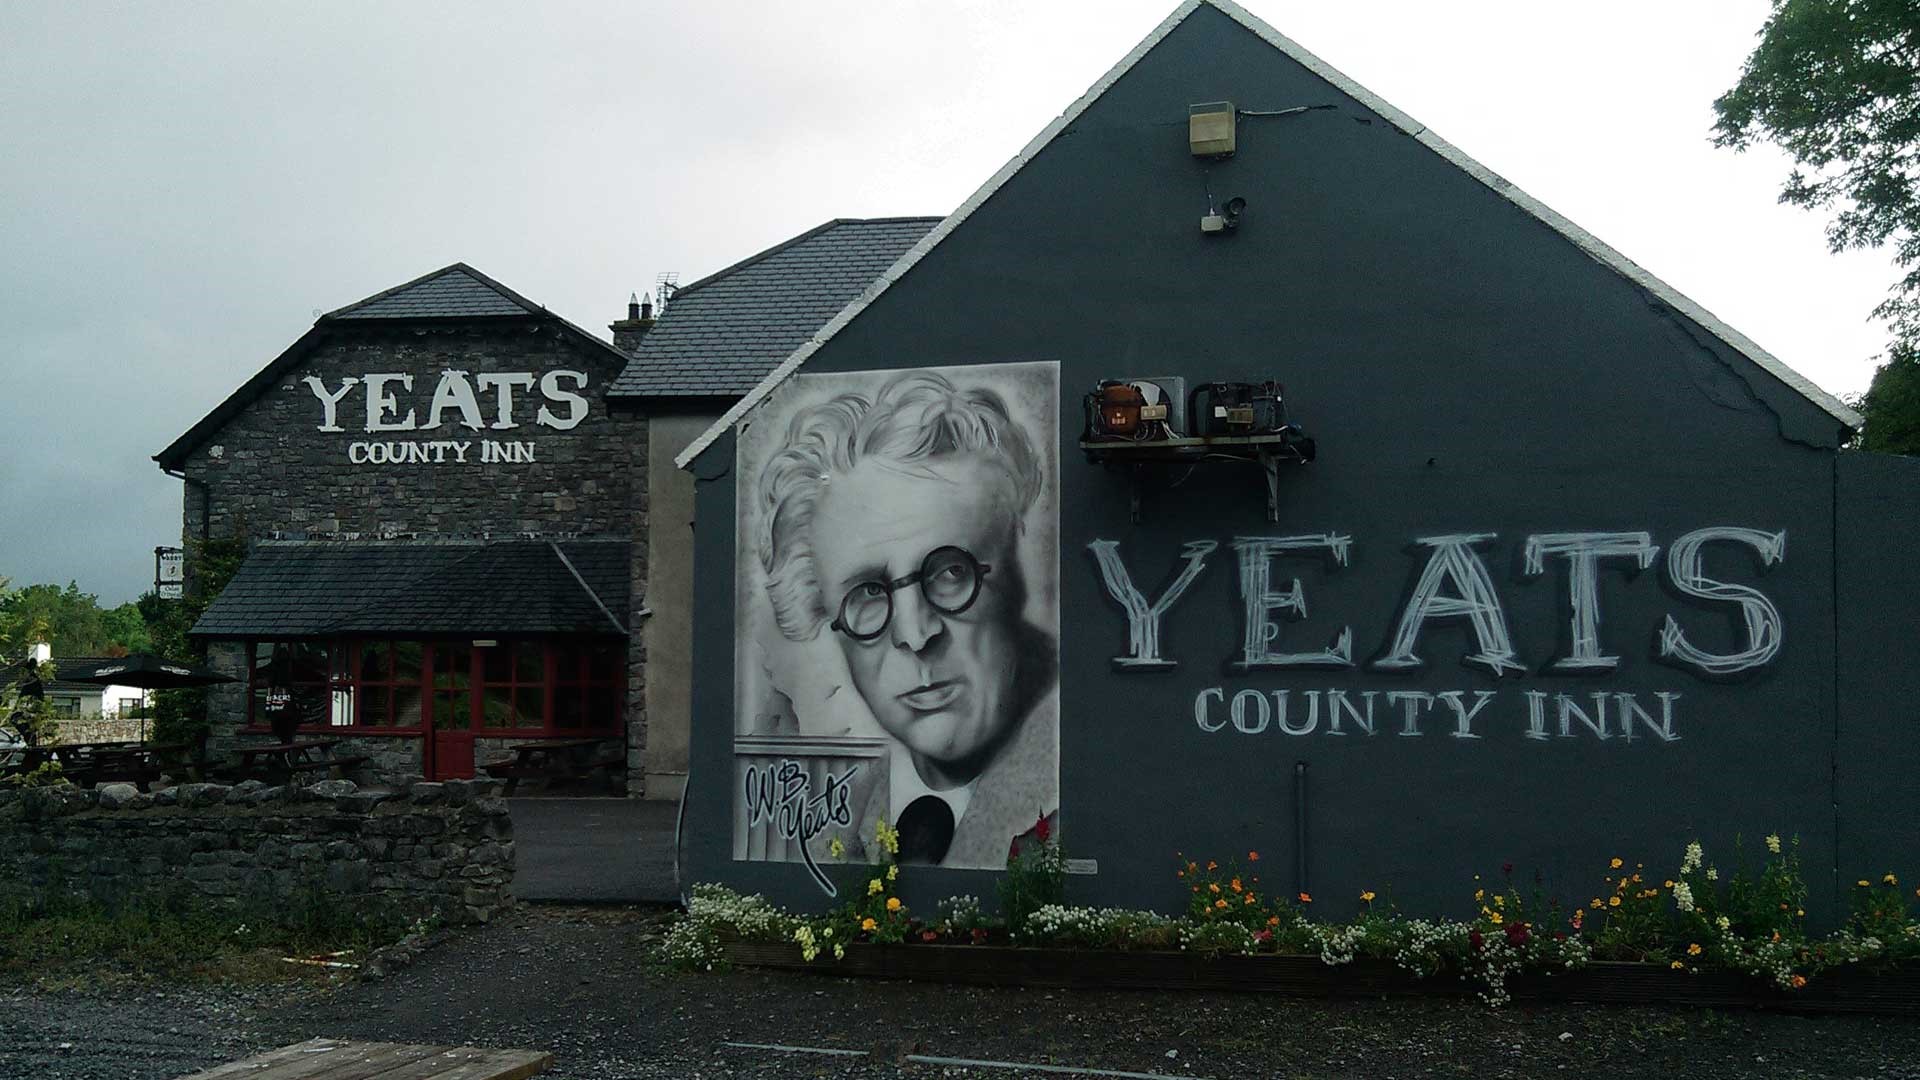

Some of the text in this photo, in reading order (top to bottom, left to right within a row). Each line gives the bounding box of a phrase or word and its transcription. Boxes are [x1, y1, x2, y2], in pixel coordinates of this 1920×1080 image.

[302, 368, 589, 432] YEATS
[349, 439, 537, 463] COUNTY INN
[1086, 526, 1786, 677] YEATS
[1194, 687, 1682, 743] COUNTY INN
[778, 764, 859, 897] Yeats
